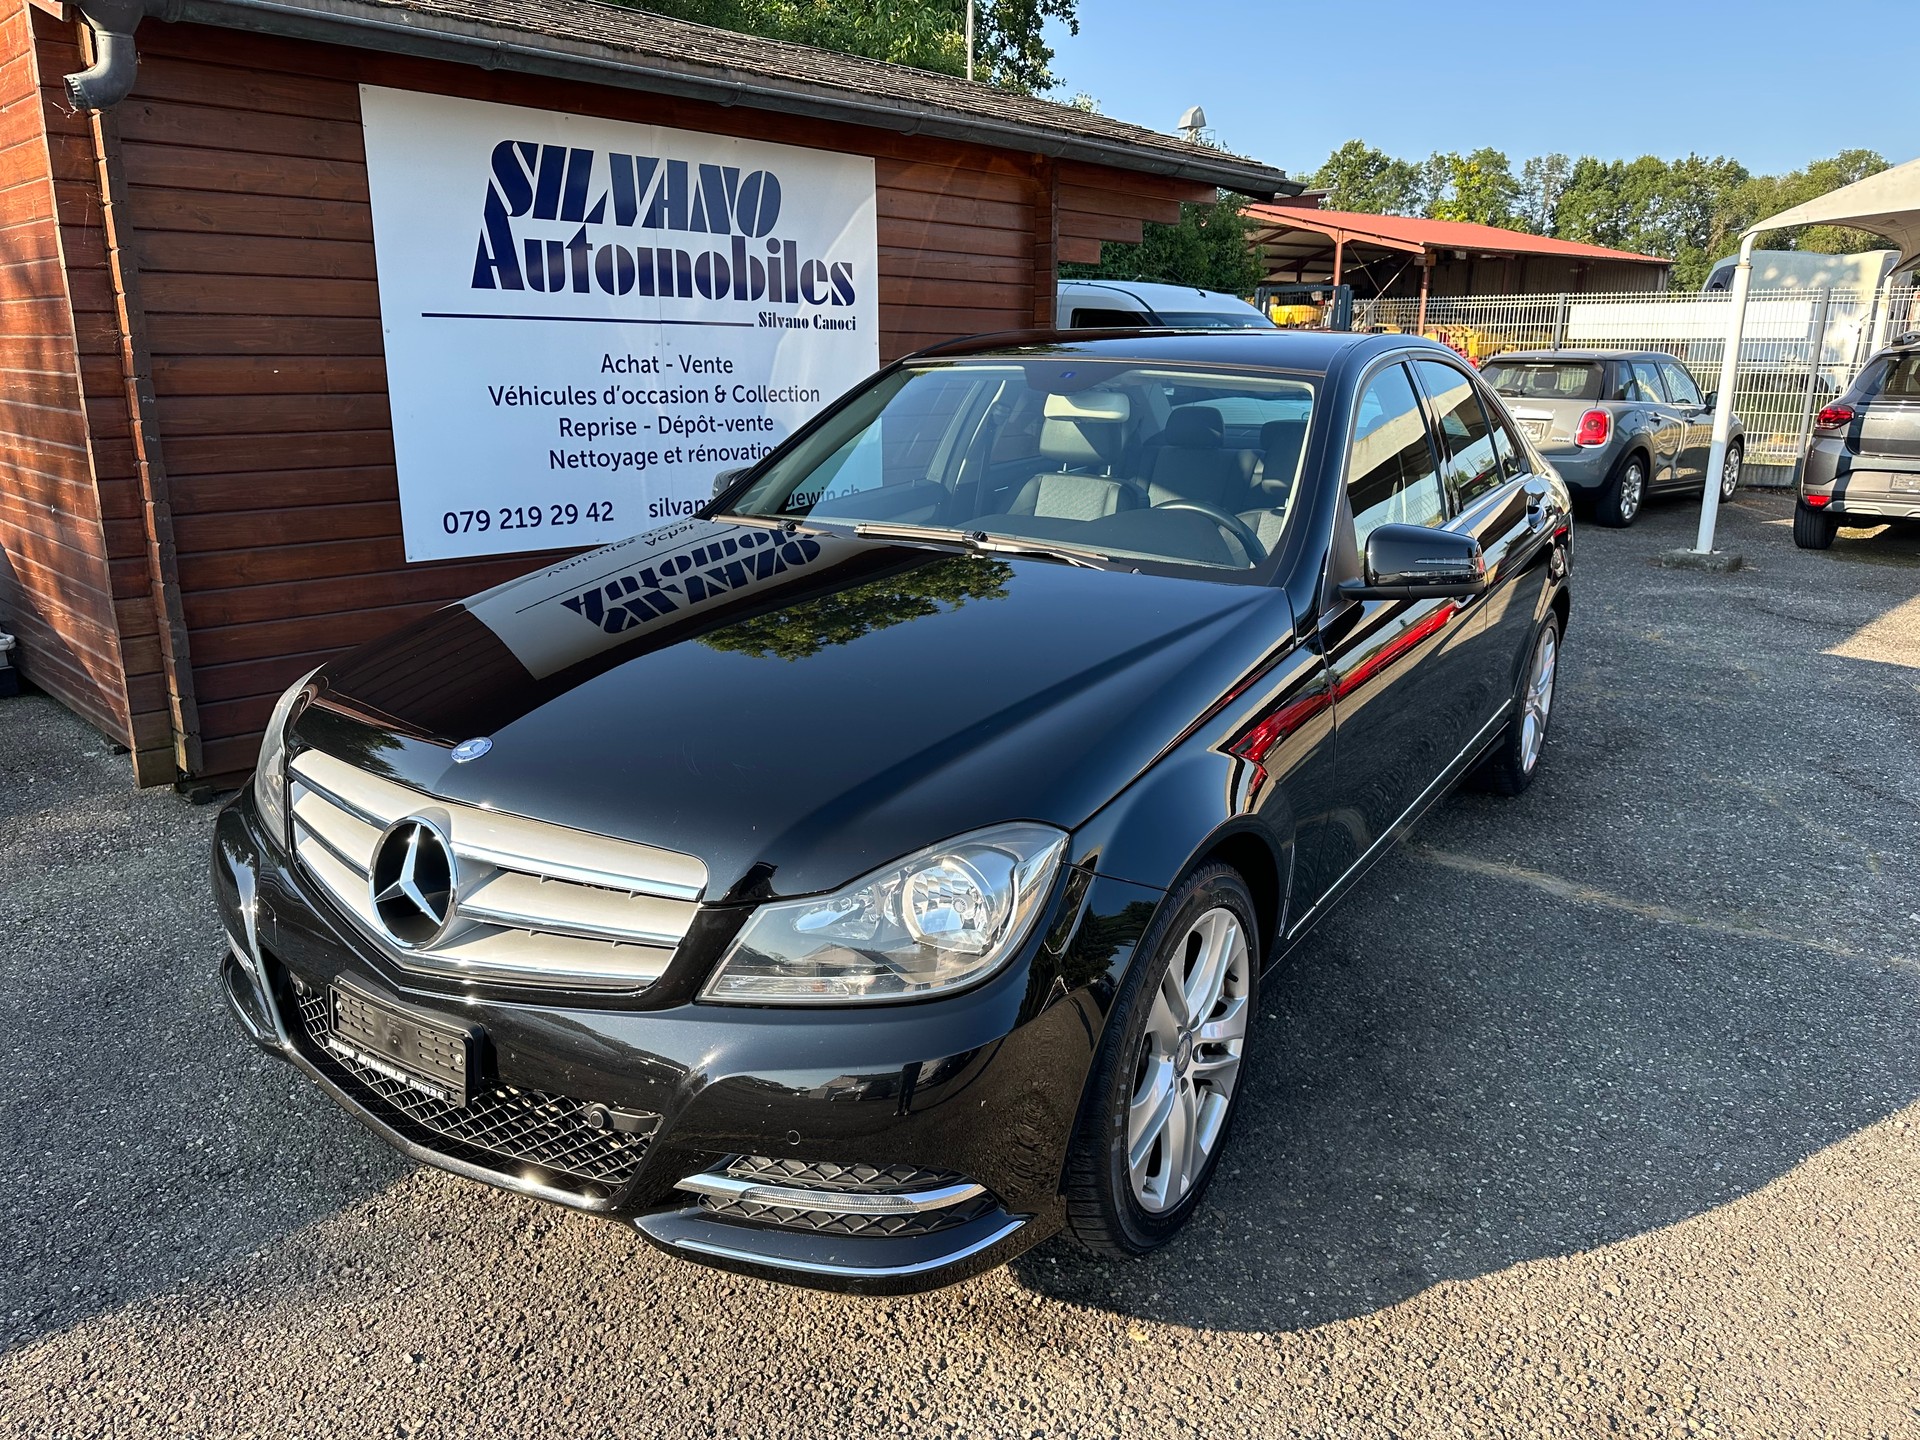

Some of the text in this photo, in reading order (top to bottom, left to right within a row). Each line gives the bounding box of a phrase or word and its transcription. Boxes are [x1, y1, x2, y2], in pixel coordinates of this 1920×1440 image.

[490, 139, 782, 238] SILVANO
[471, 180, 856, 306] Automobiles
[758, 311, 856, 331] Silvano Canoci
[600, 353, 660, 374] Achat
[678, 354, 734, 374] Vente
[488, 385, 598, 407] Véhicules
[714, 384, 727, 404] &
[732, 384, 820, 404] Collection
[559, 416, 637, 440] Reprise
[657, 414, 774, 438] Dépôt-vente
[549, 441, 777, 473] Nettoyage et rénovatio
[442, 509, 491, 535] 079
[498, 505, 543, 530] 219
[549, 503, 579, 526] 29
[585, 500, 615, 523] 42
[648, 497, 712, 518] silvan
